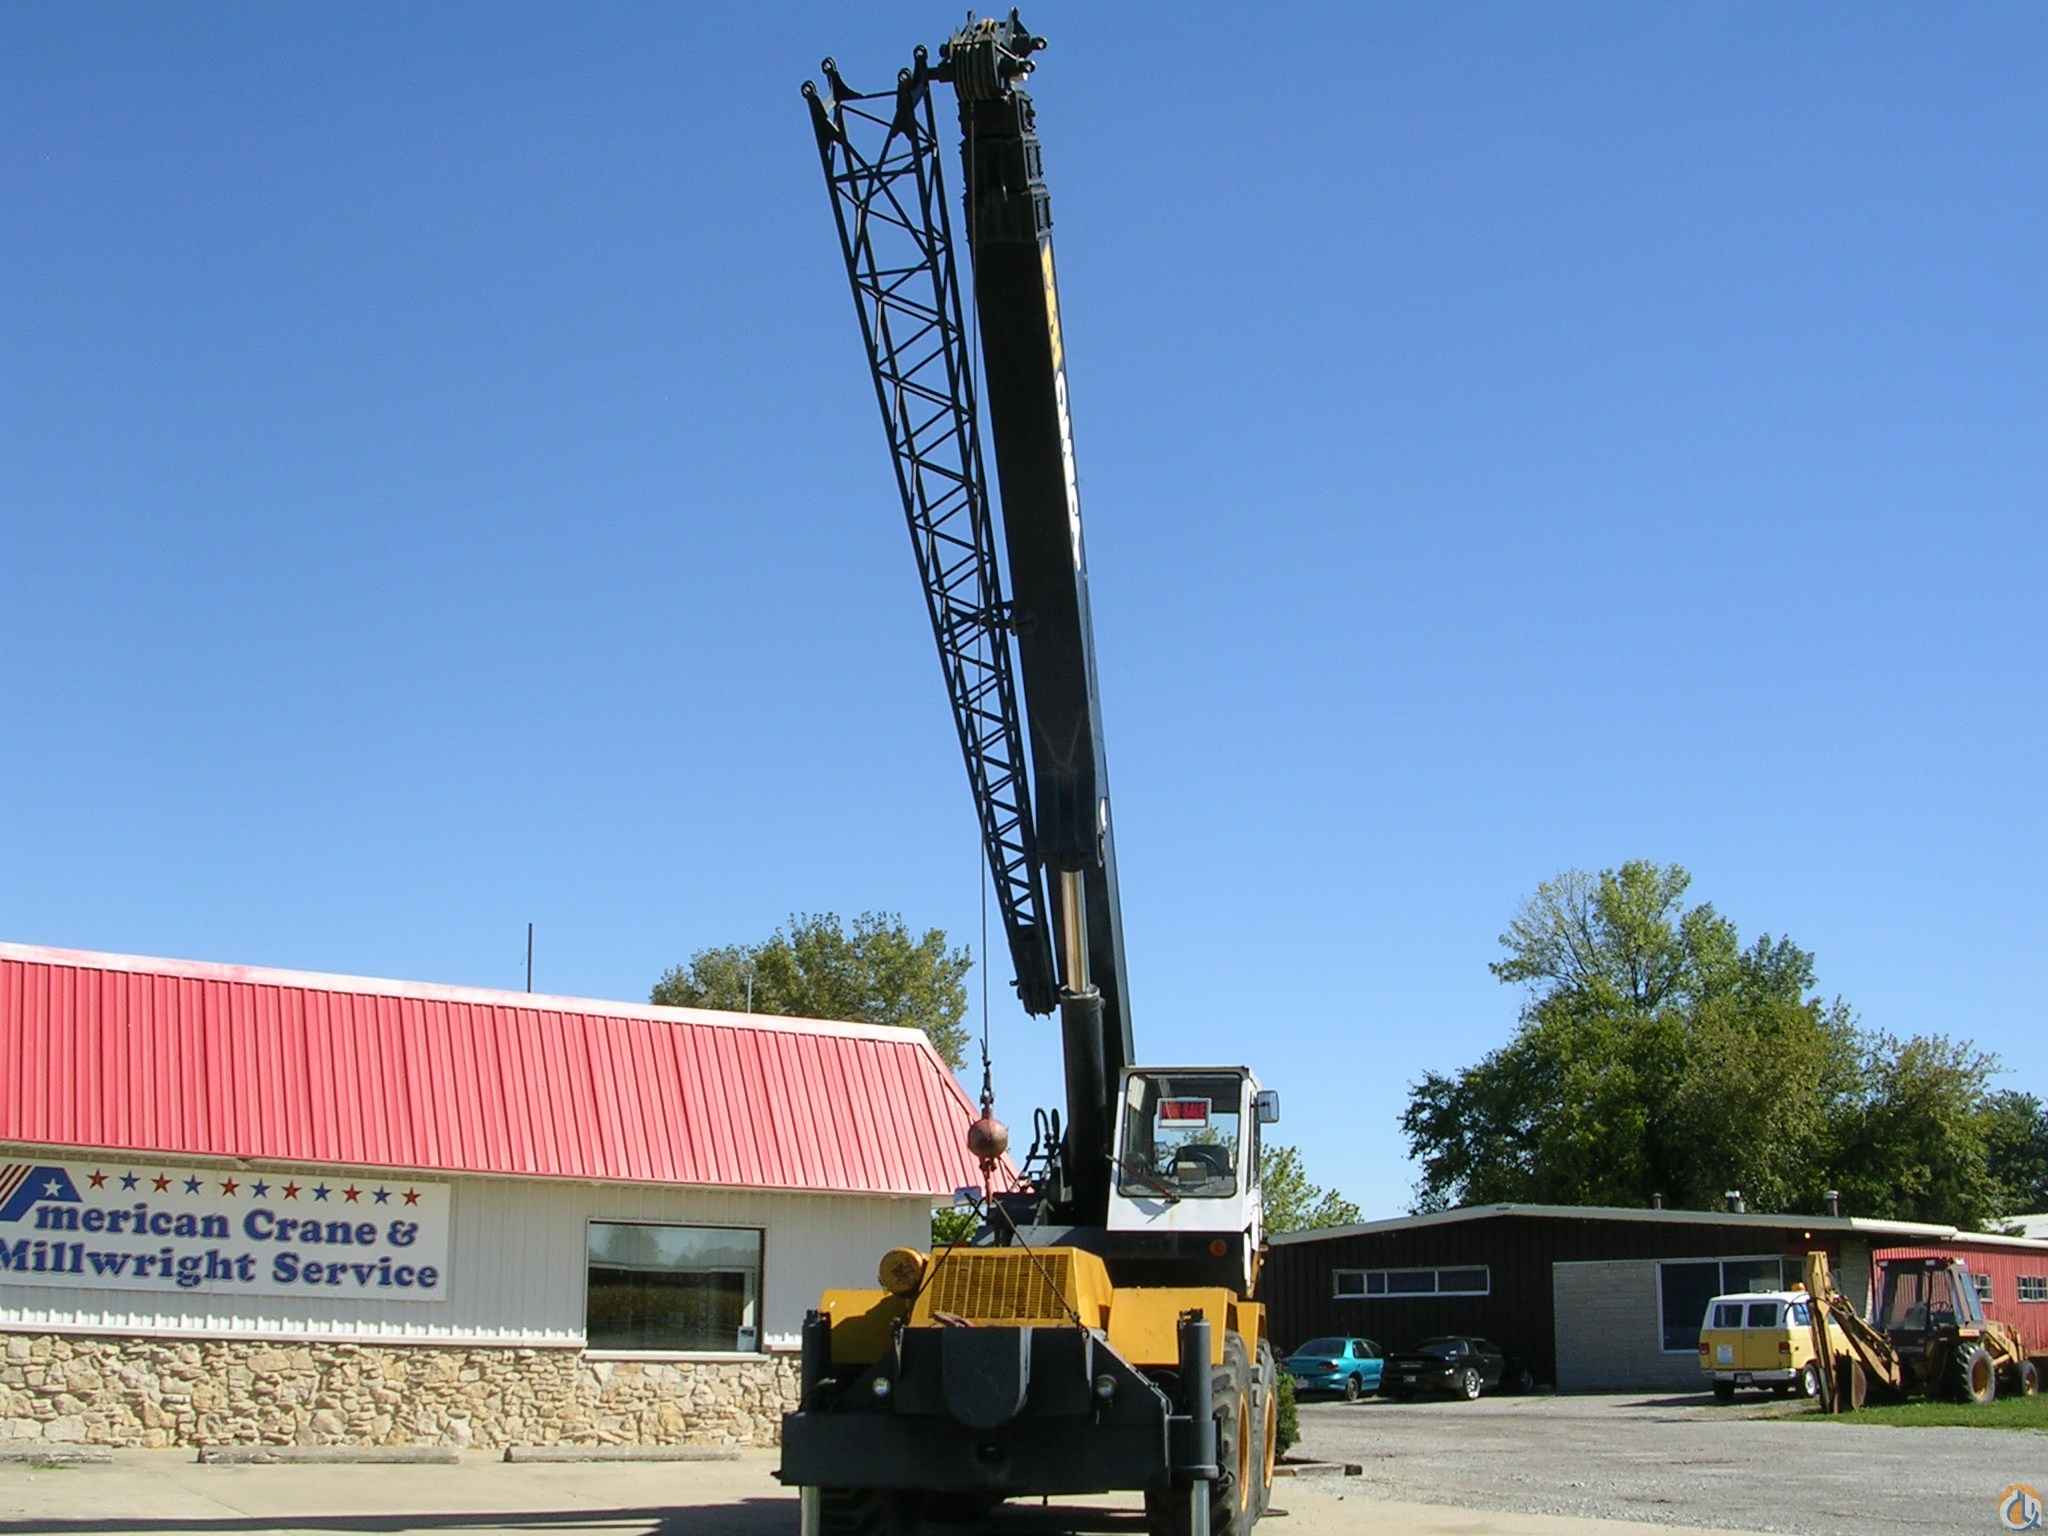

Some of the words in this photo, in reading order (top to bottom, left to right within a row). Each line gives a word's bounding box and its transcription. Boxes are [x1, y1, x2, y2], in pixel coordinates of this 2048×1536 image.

[243, 1208, 377, 1246] Crane
[387, 1219, 419, 1247] &
[272, 1251, 439, 1288] Service
